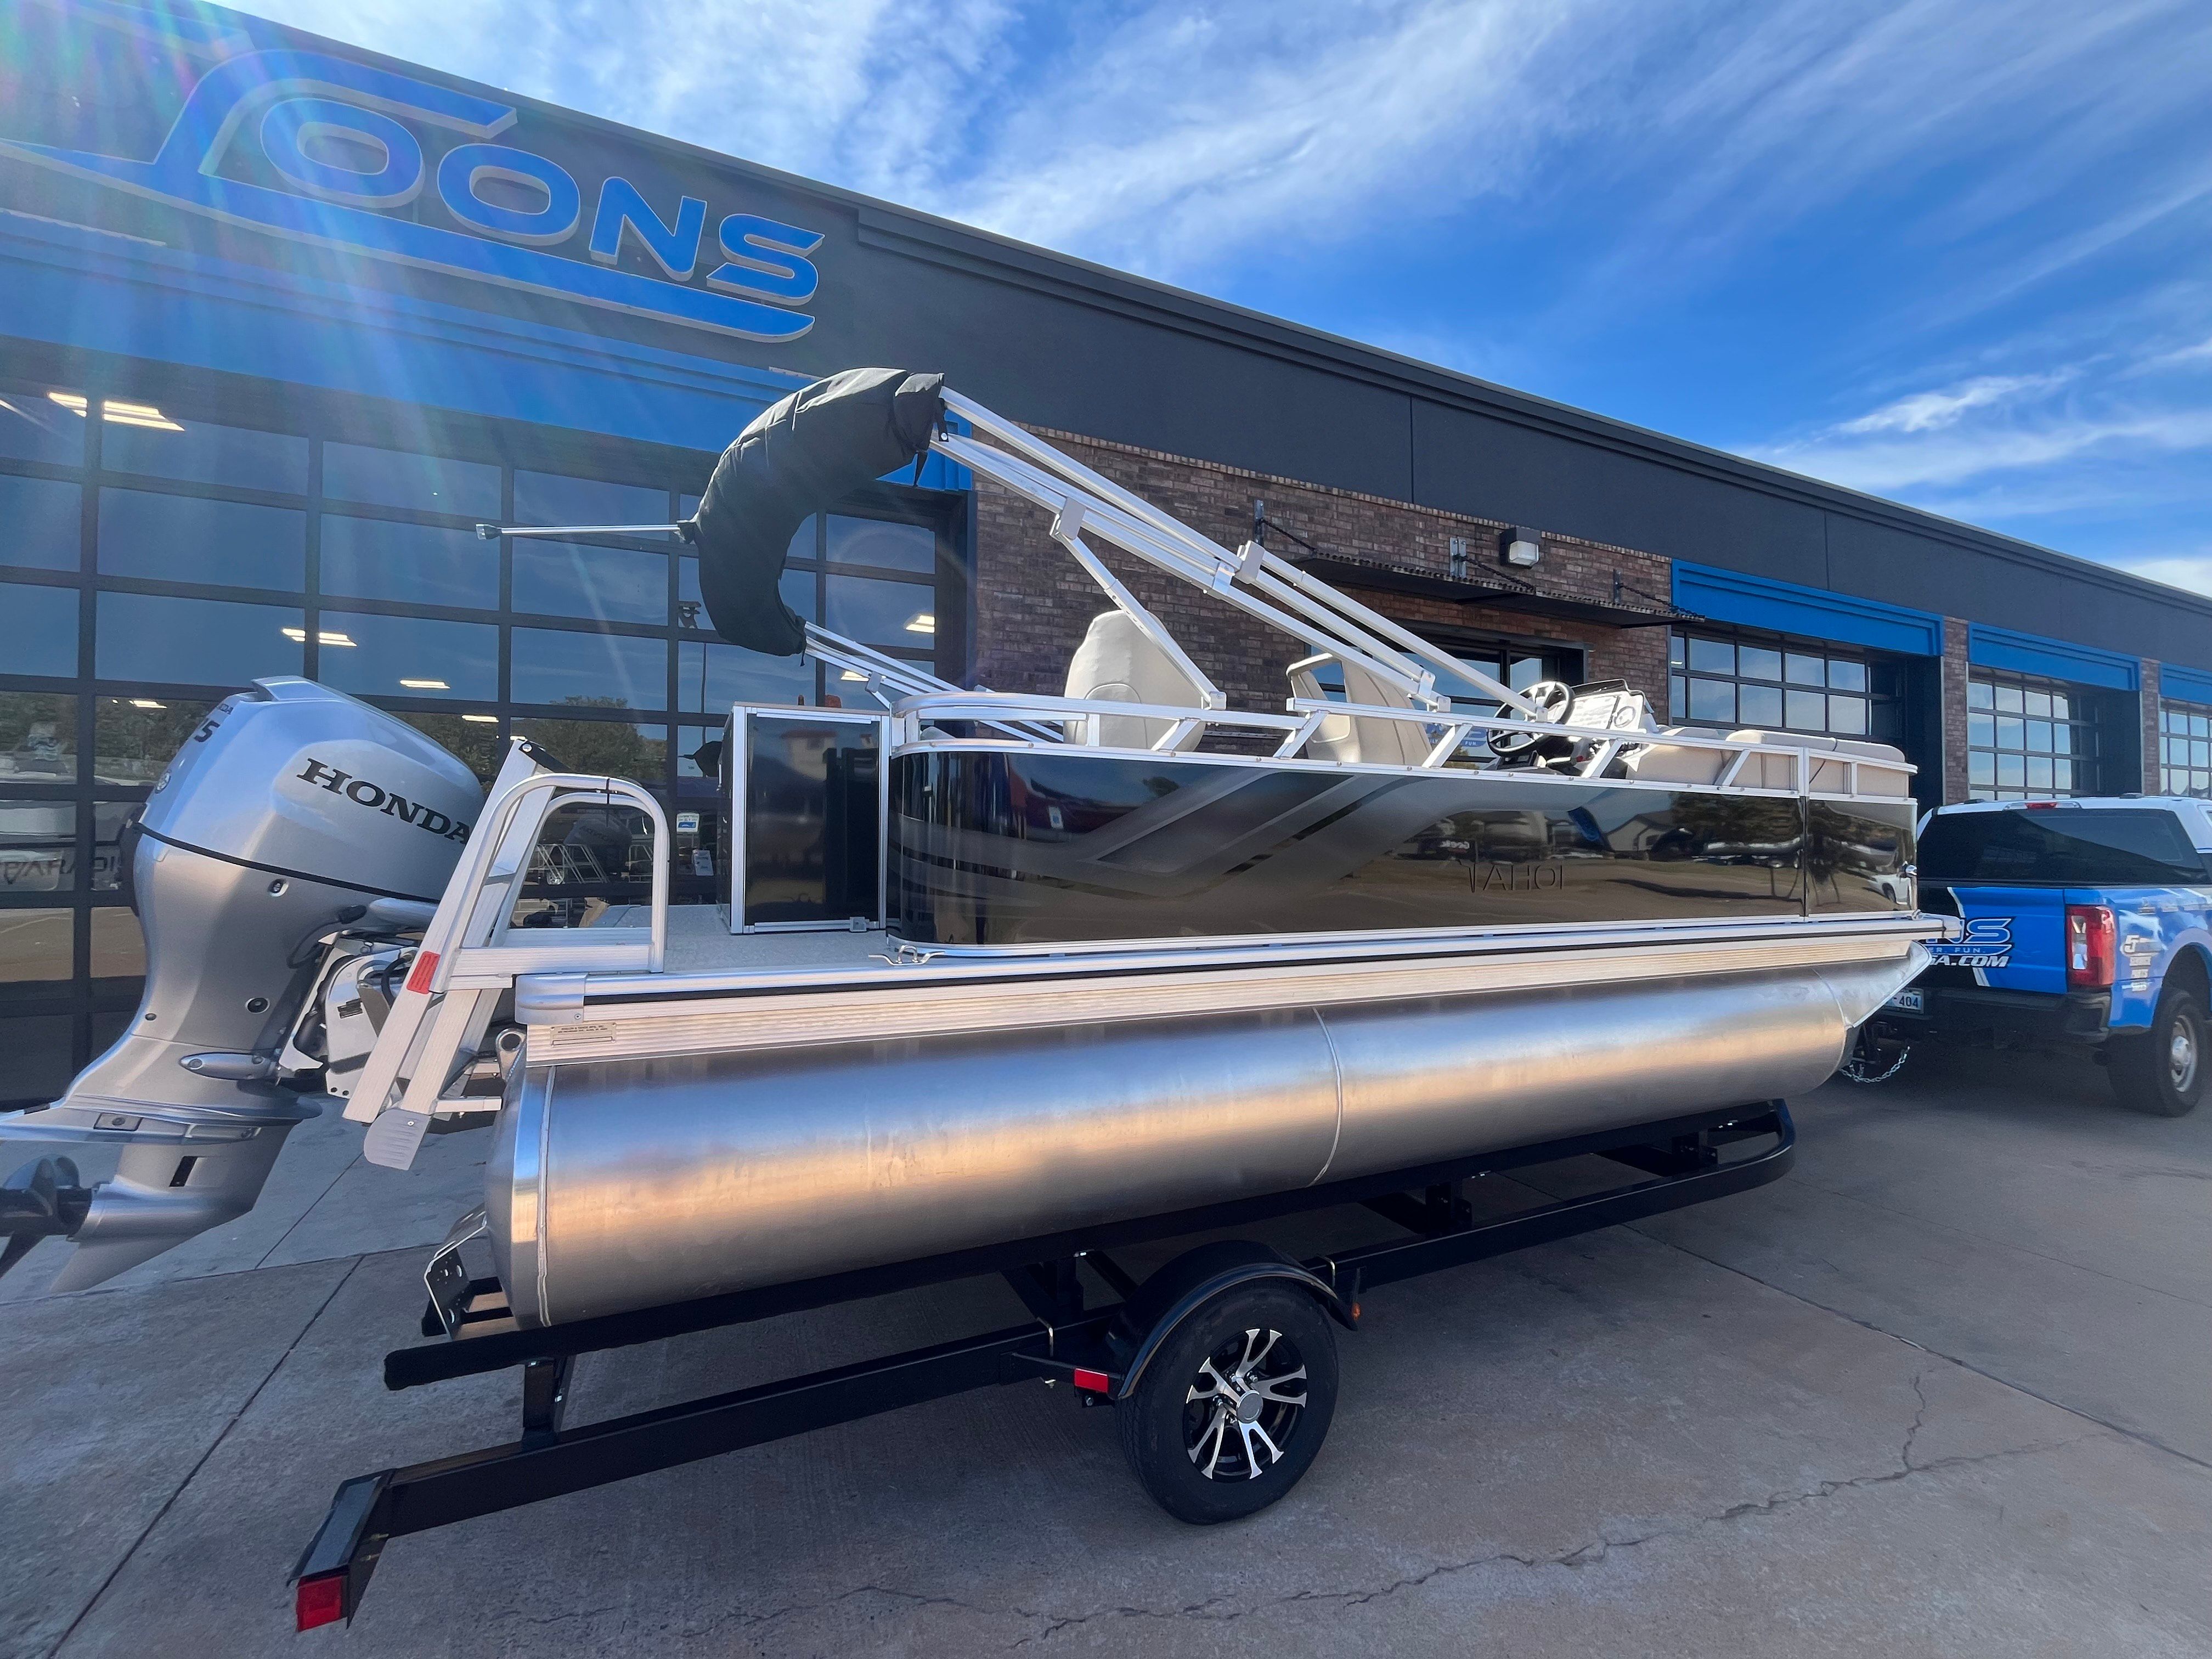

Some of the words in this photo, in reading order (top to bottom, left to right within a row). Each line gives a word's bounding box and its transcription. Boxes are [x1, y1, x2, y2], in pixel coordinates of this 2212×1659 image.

[0, 48, 825, 342] LOONS
[297, 758, 470, 845] HONDA
[1893, 995, 1918, 1008] -404
